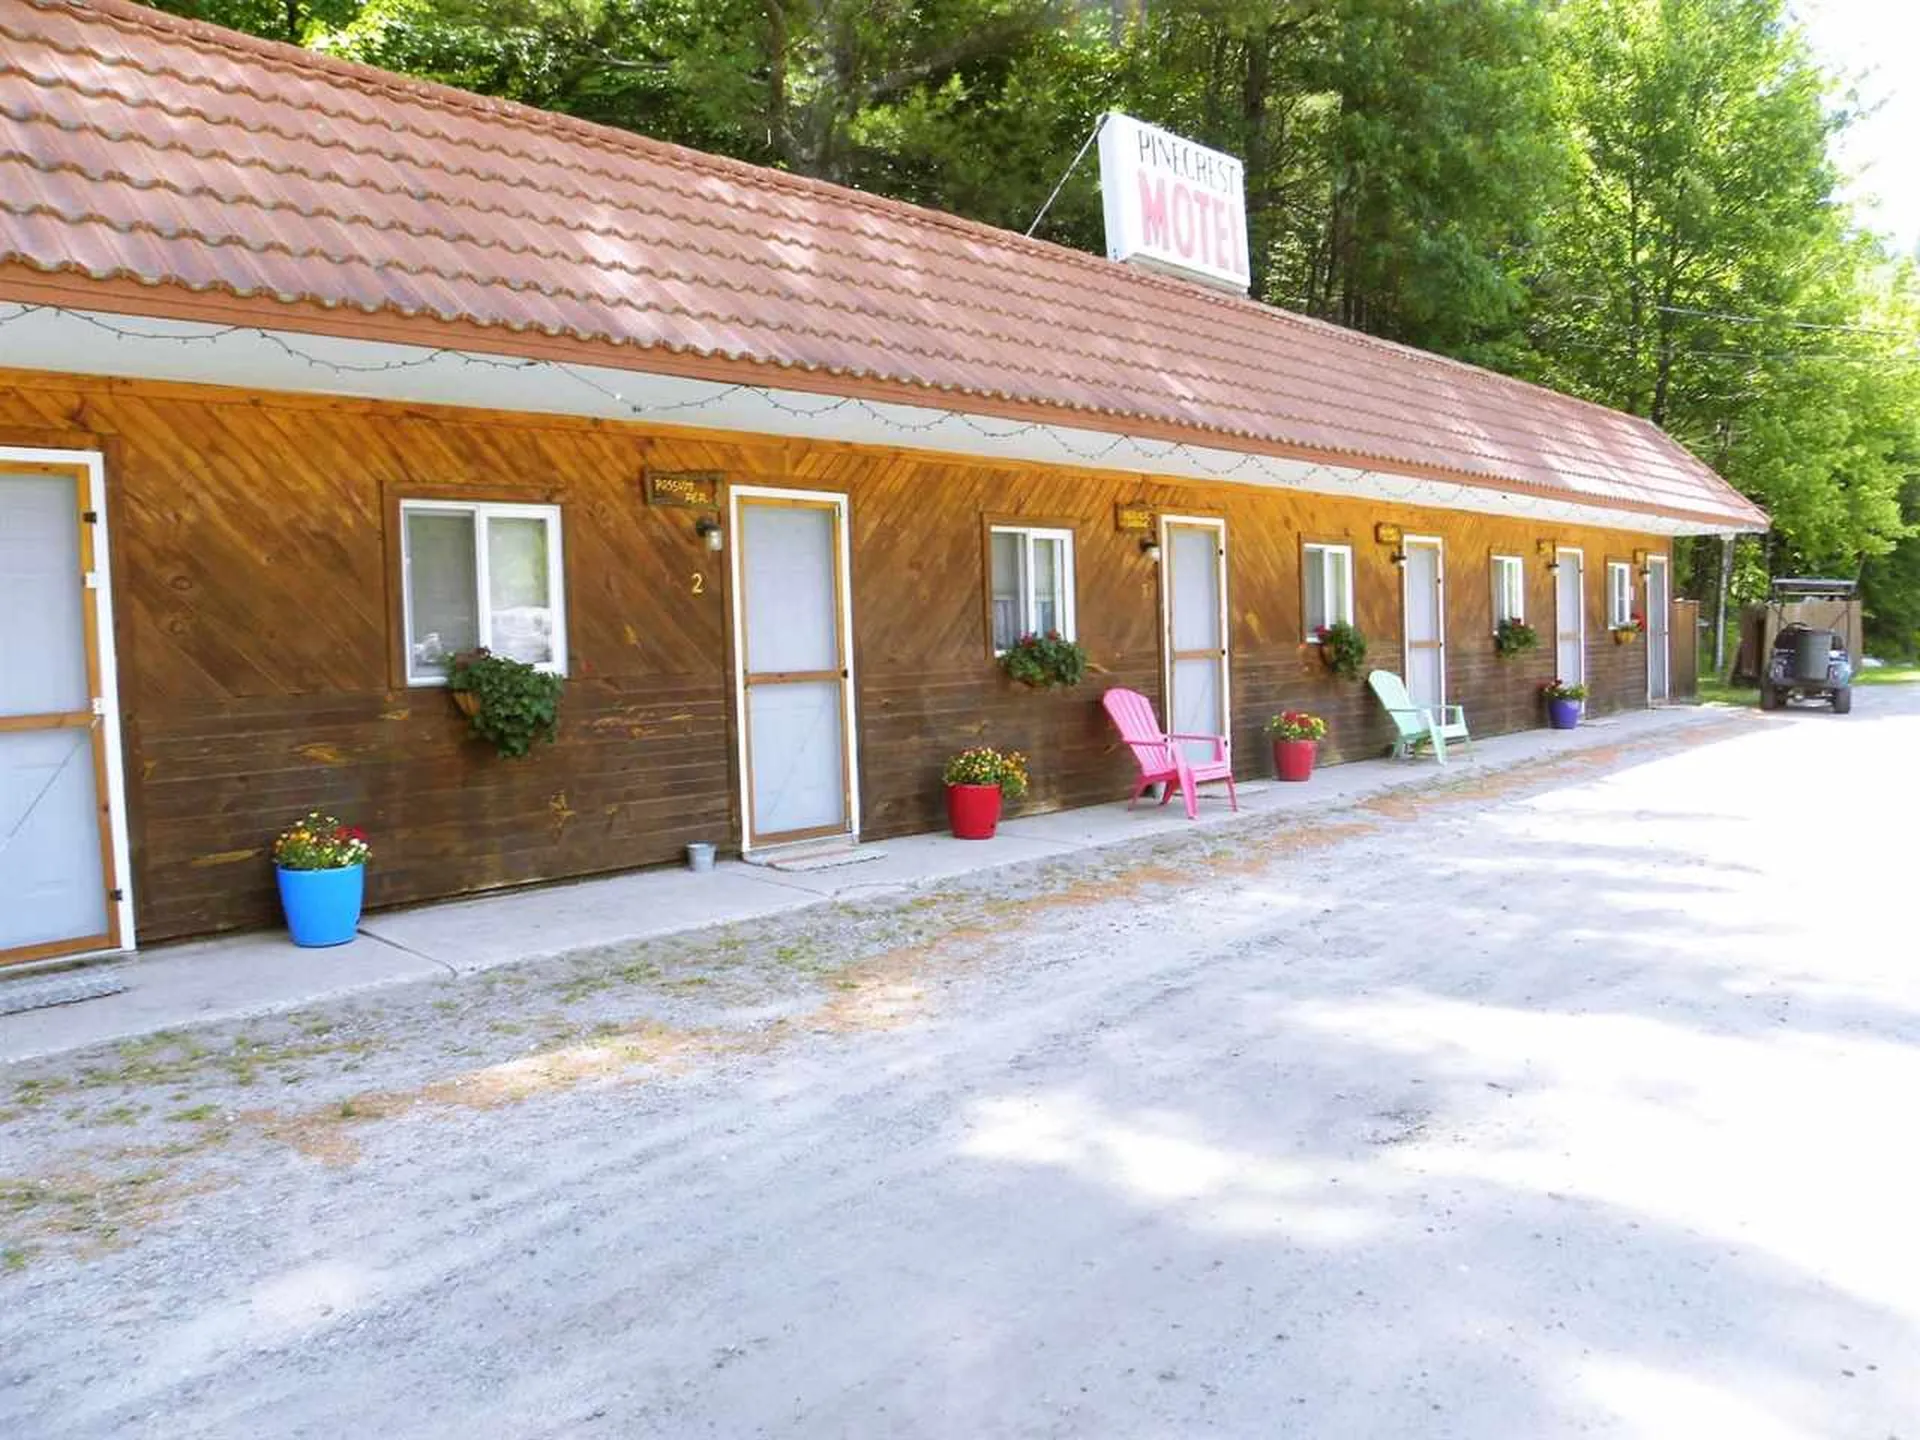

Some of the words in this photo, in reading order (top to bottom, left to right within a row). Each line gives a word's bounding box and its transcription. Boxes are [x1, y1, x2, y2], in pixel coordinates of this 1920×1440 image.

[1137, 129, 1236, 195] PINECREST
[1137, 168, 1247, 276] MOTEL
[691, 573, 703, 594] 2
